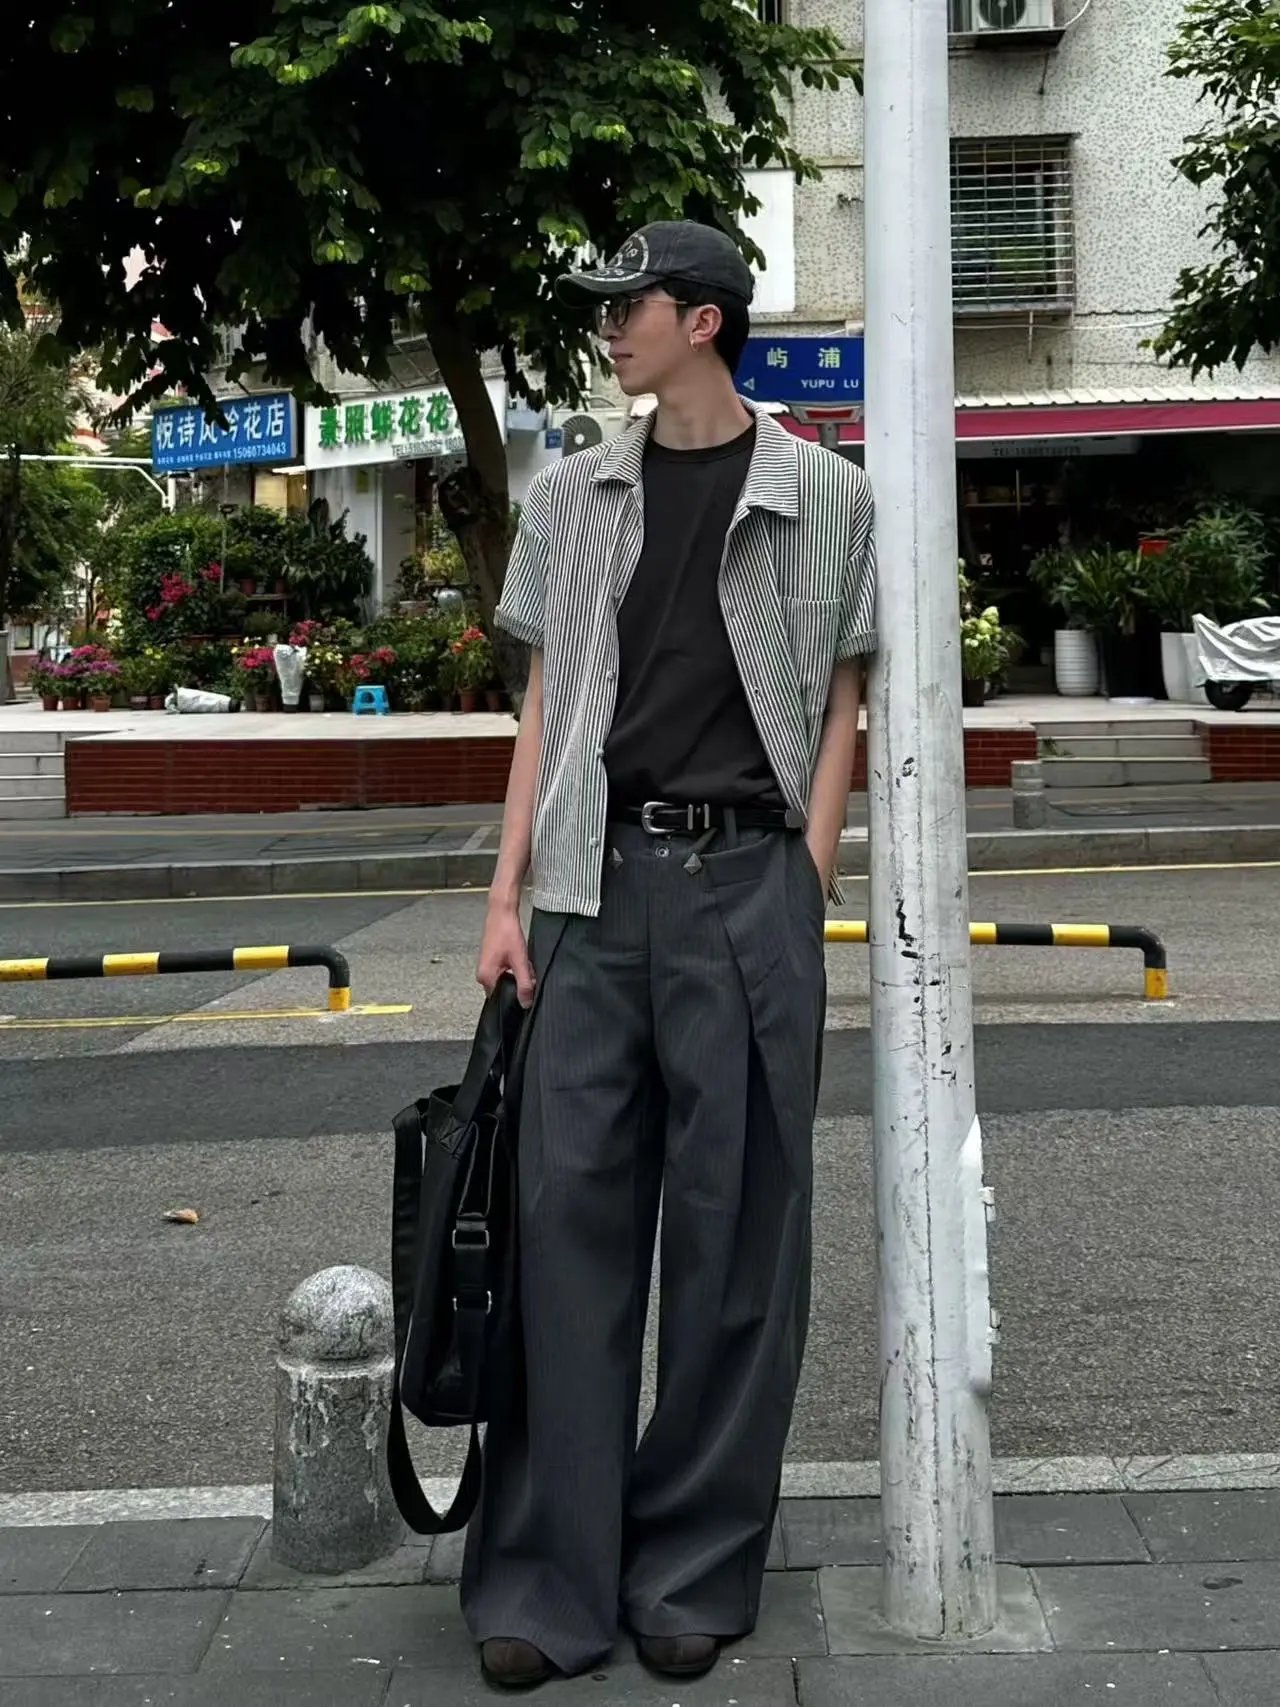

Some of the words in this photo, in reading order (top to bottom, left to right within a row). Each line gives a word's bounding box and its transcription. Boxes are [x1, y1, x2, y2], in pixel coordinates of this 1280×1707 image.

[767, 347, 841, 369] 屿浦
[801, 379, 835, 388] YUPU
[844, 379, 859, 388] LU
[319, 391, 461, 448] 景照鲜花花
